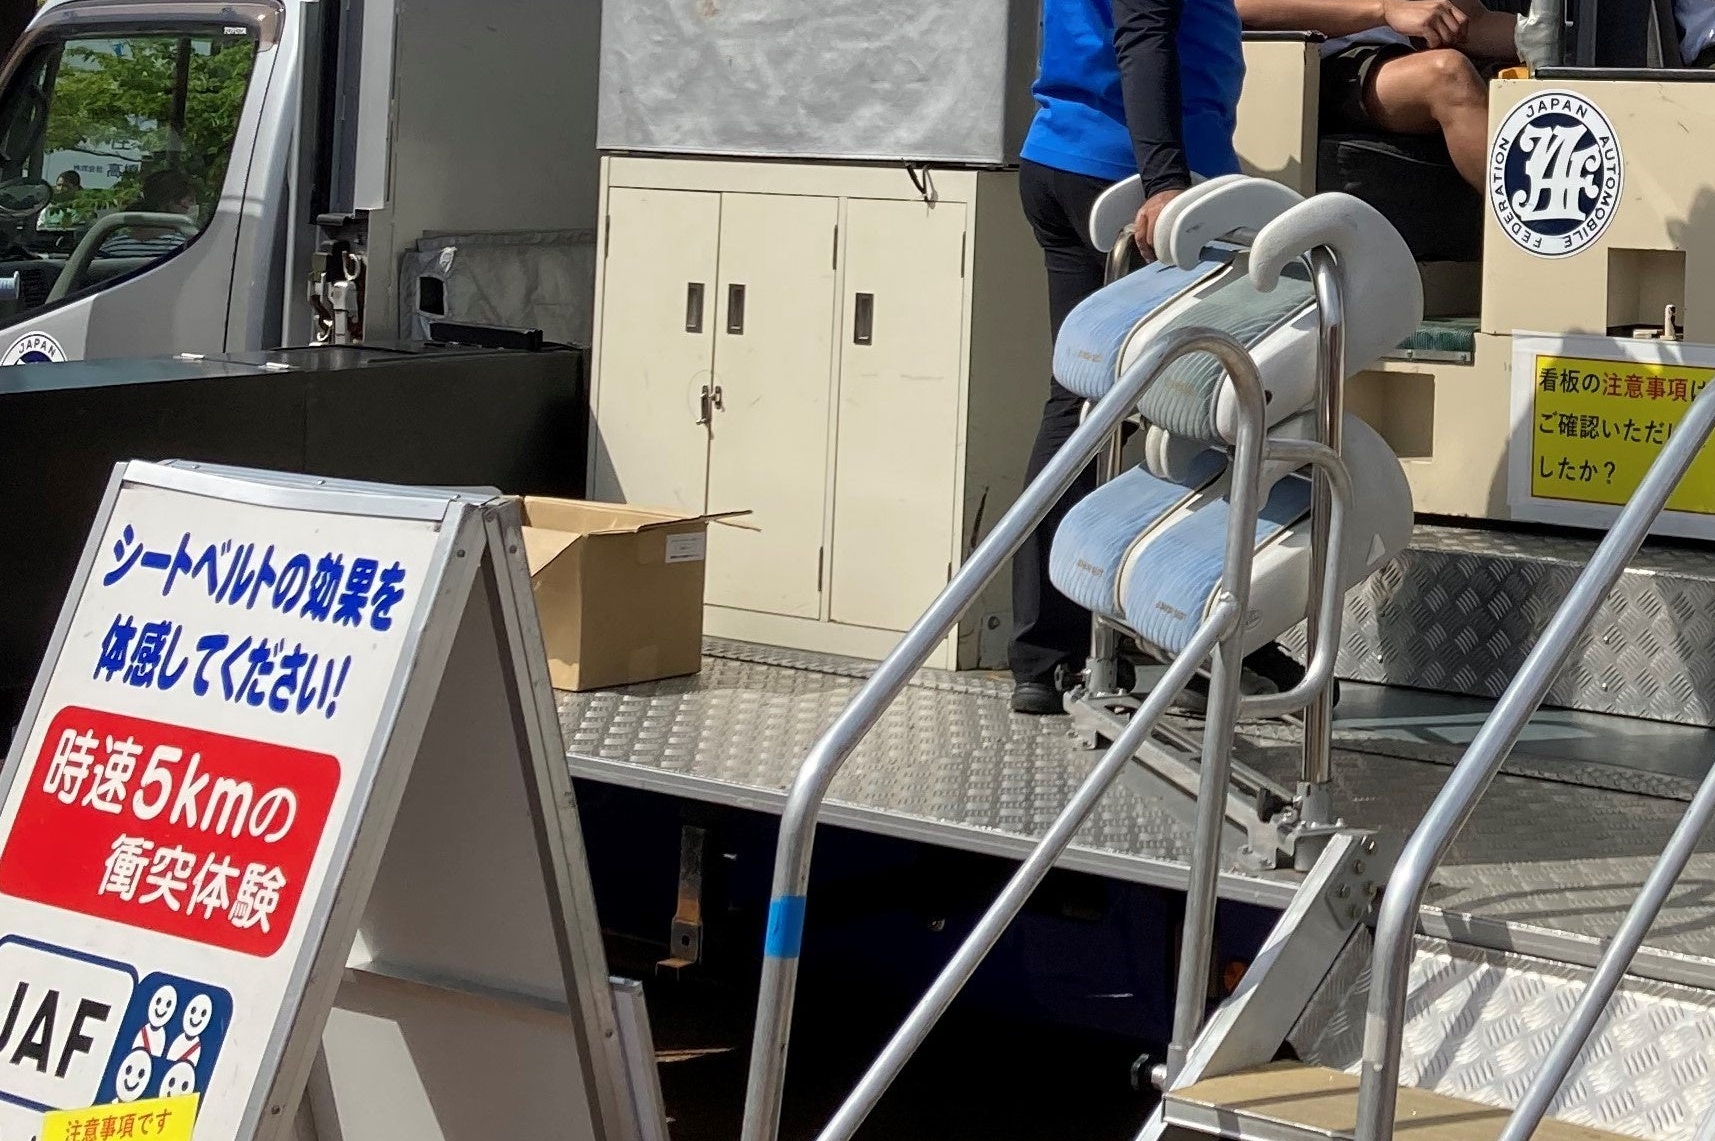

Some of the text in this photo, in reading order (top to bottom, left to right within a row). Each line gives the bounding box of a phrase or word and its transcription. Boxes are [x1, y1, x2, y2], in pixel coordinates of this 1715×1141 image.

[1526, 97, 1588, 119] JAPAN
[1493, 137, 1543, 249] FEDERATION
[1564, 135, 1616, 249] AUTOMOBILE
[18, 338, 57, 358] JAPAN
[1539, 410, 1672, 445] ご確認いただ
[103, 524, 406, 632] シートベルトの効果を
[43, 728, 298, 843] 時速5kmの
[97, 833, 287, 934] 衝突体験
[0, 981, 112, 1078] JAF
[65, 1108, 172, 1141] 注意事項です
